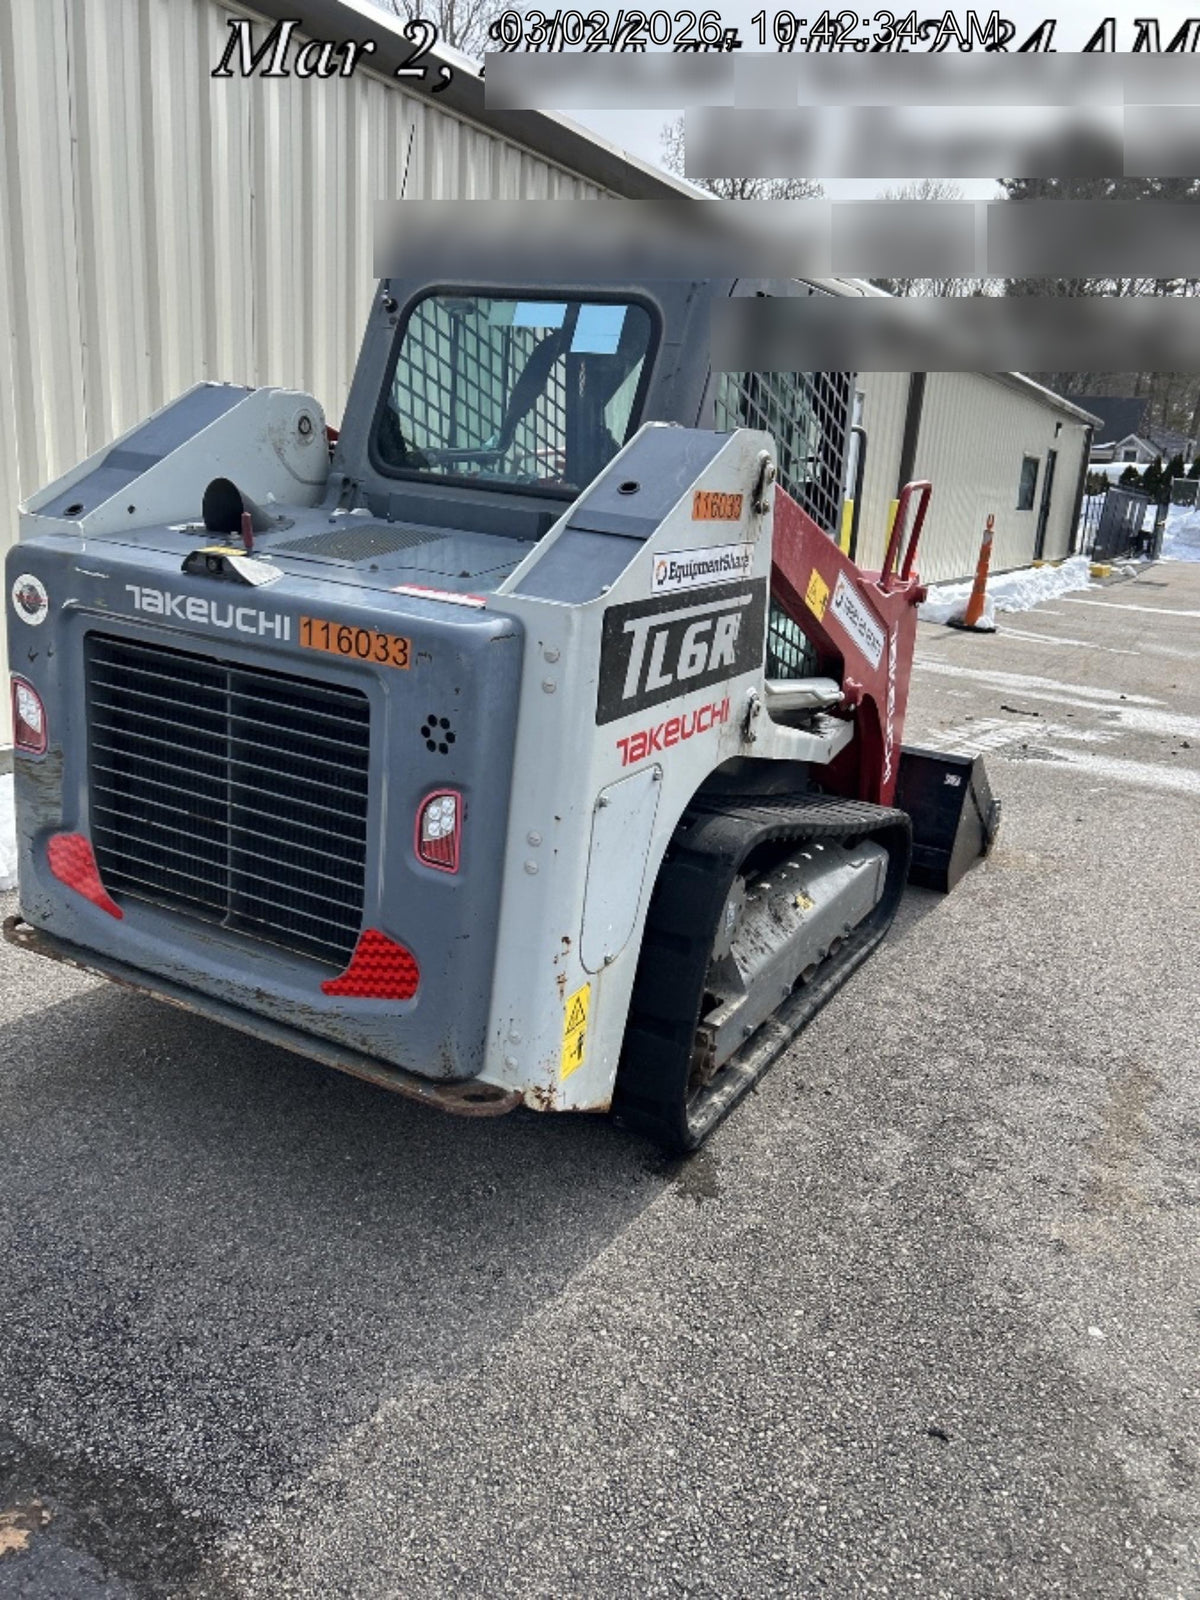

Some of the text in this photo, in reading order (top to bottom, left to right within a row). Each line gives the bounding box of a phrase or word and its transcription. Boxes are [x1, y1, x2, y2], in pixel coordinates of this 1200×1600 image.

[668, 553, 750, 583] EquipmentShare
[126, 584, 290, 641] TAKEUCHI
[301, 618, 409, 667] 116033
[622, 593, 753, 701] TL6R
[616, 696, 731, 767] TAKEUCHI
